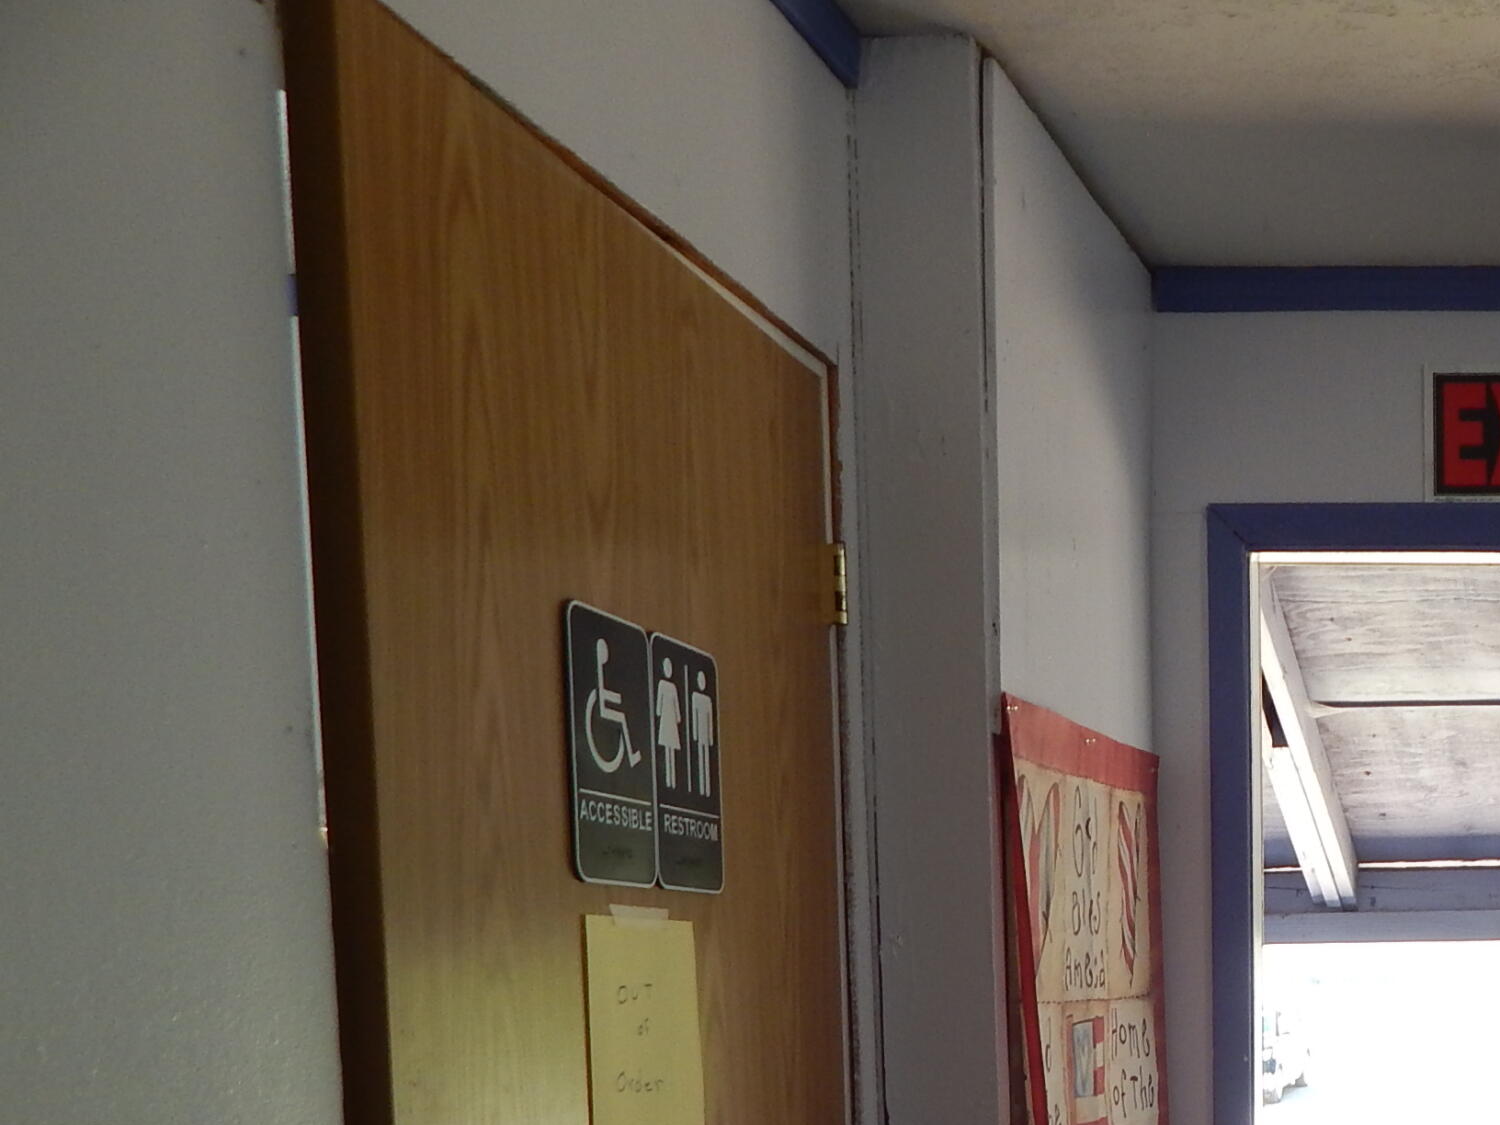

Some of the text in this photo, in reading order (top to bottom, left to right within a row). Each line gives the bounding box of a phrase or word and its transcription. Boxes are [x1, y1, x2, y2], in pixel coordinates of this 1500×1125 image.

[579, 798, 653, 832] ACCESSIBLE
[663, 813, 719, 842] RESTROOM
[1111, 1006, 1151, 1061] Home
[1112, 1067, 1127, 1119] of
